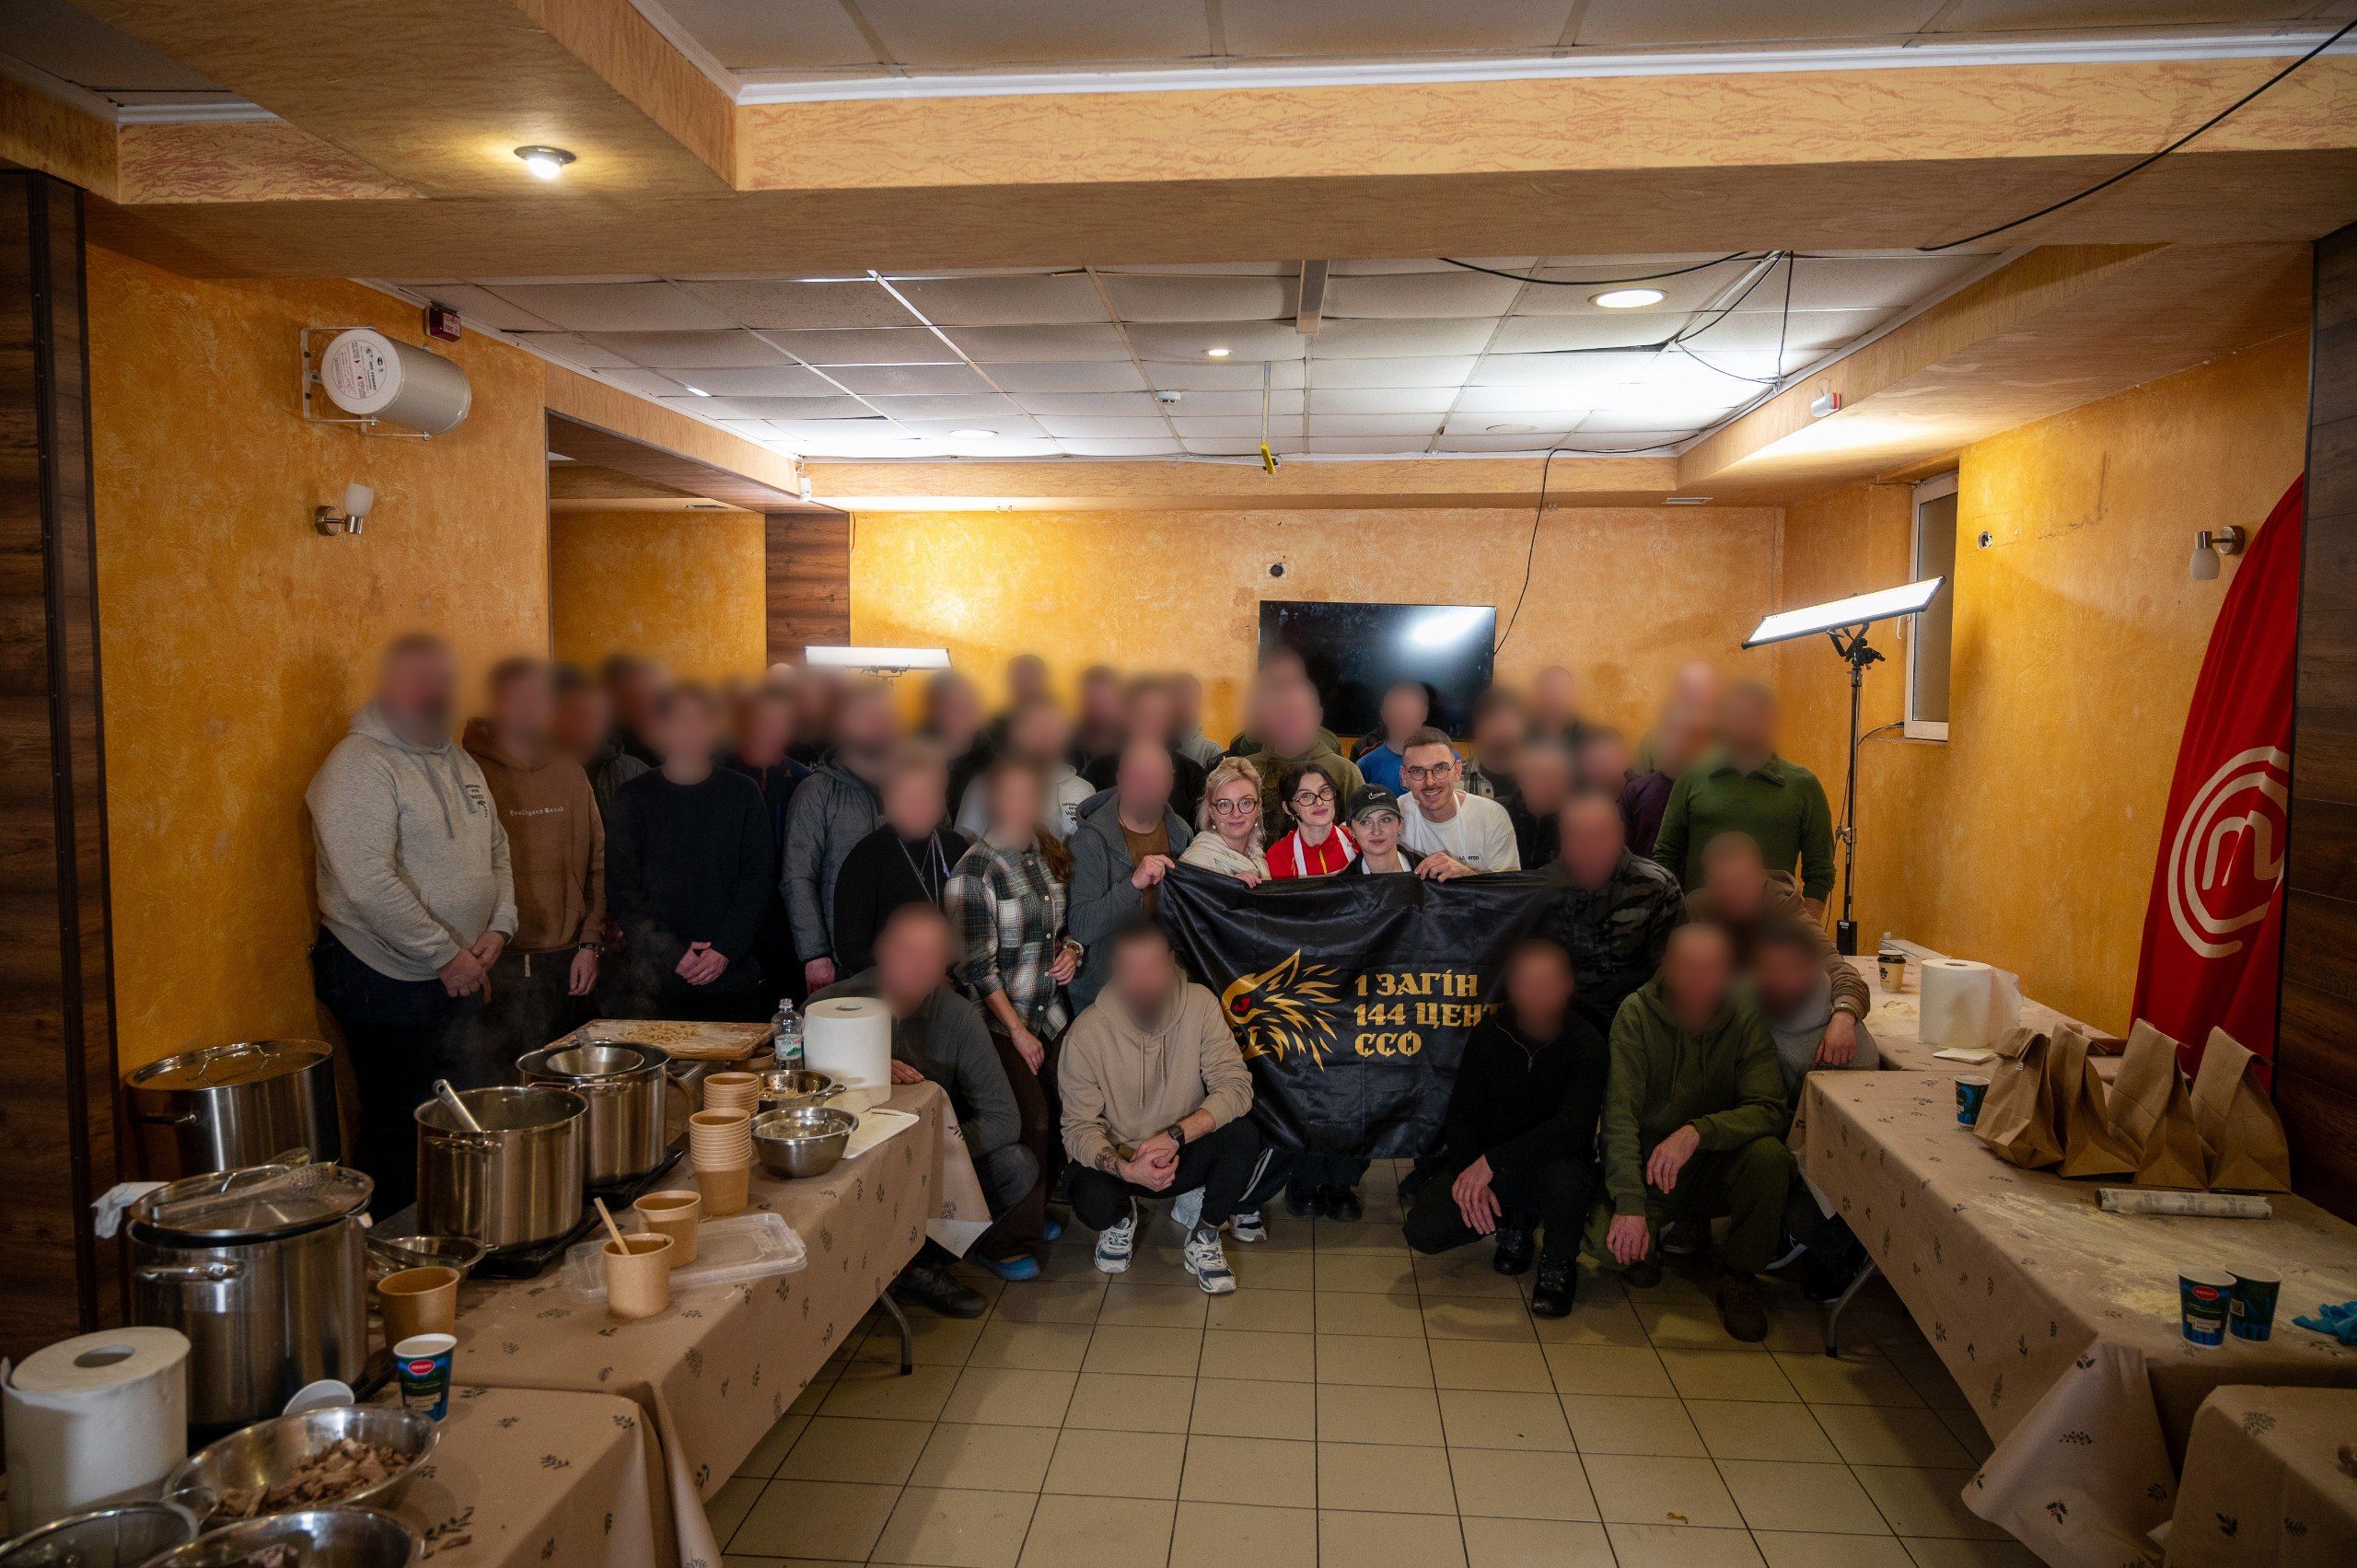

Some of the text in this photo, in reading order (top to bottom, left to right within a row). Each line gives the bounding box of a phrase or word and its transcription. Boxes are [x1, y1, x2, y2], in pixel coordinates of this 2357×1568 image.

[1354, 969, 1479, 997] 1 ЗАГІН
[1353, 1003, 1407, 1027] 144
[1354, 1029, 1422, 1058] ССО
